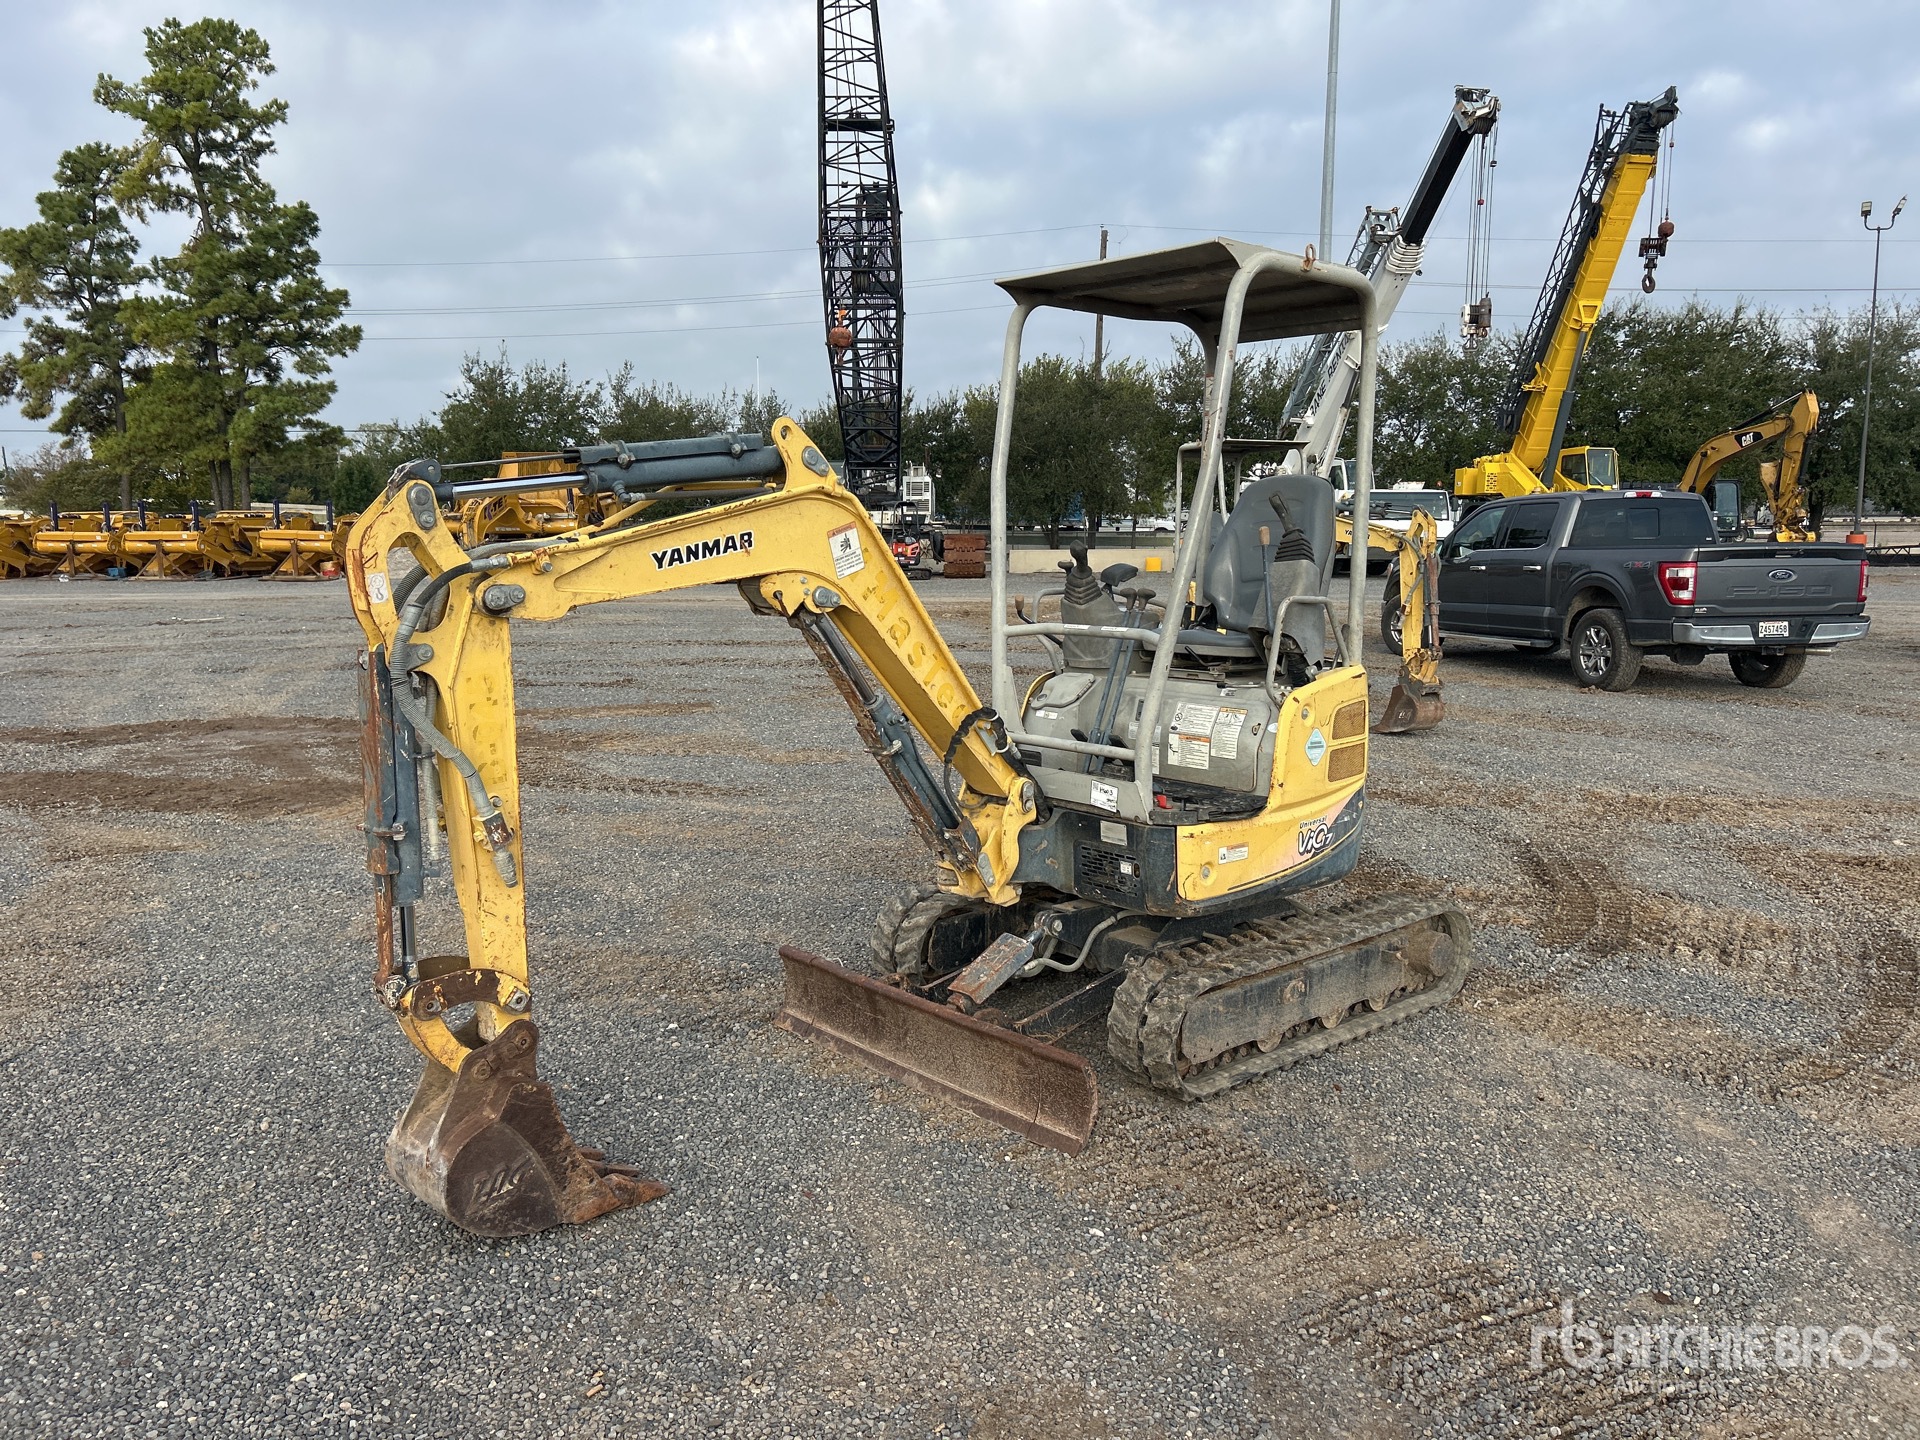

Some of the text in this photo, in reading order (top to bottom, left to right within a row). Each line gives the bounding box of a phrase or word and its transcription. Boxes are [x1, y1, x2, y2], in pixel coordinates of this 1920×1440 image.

[1741, 432, 1754, 447] CAT
[651, 531, 753, 570] YANMAR
[1726, 584, 1833, 598] F-150
